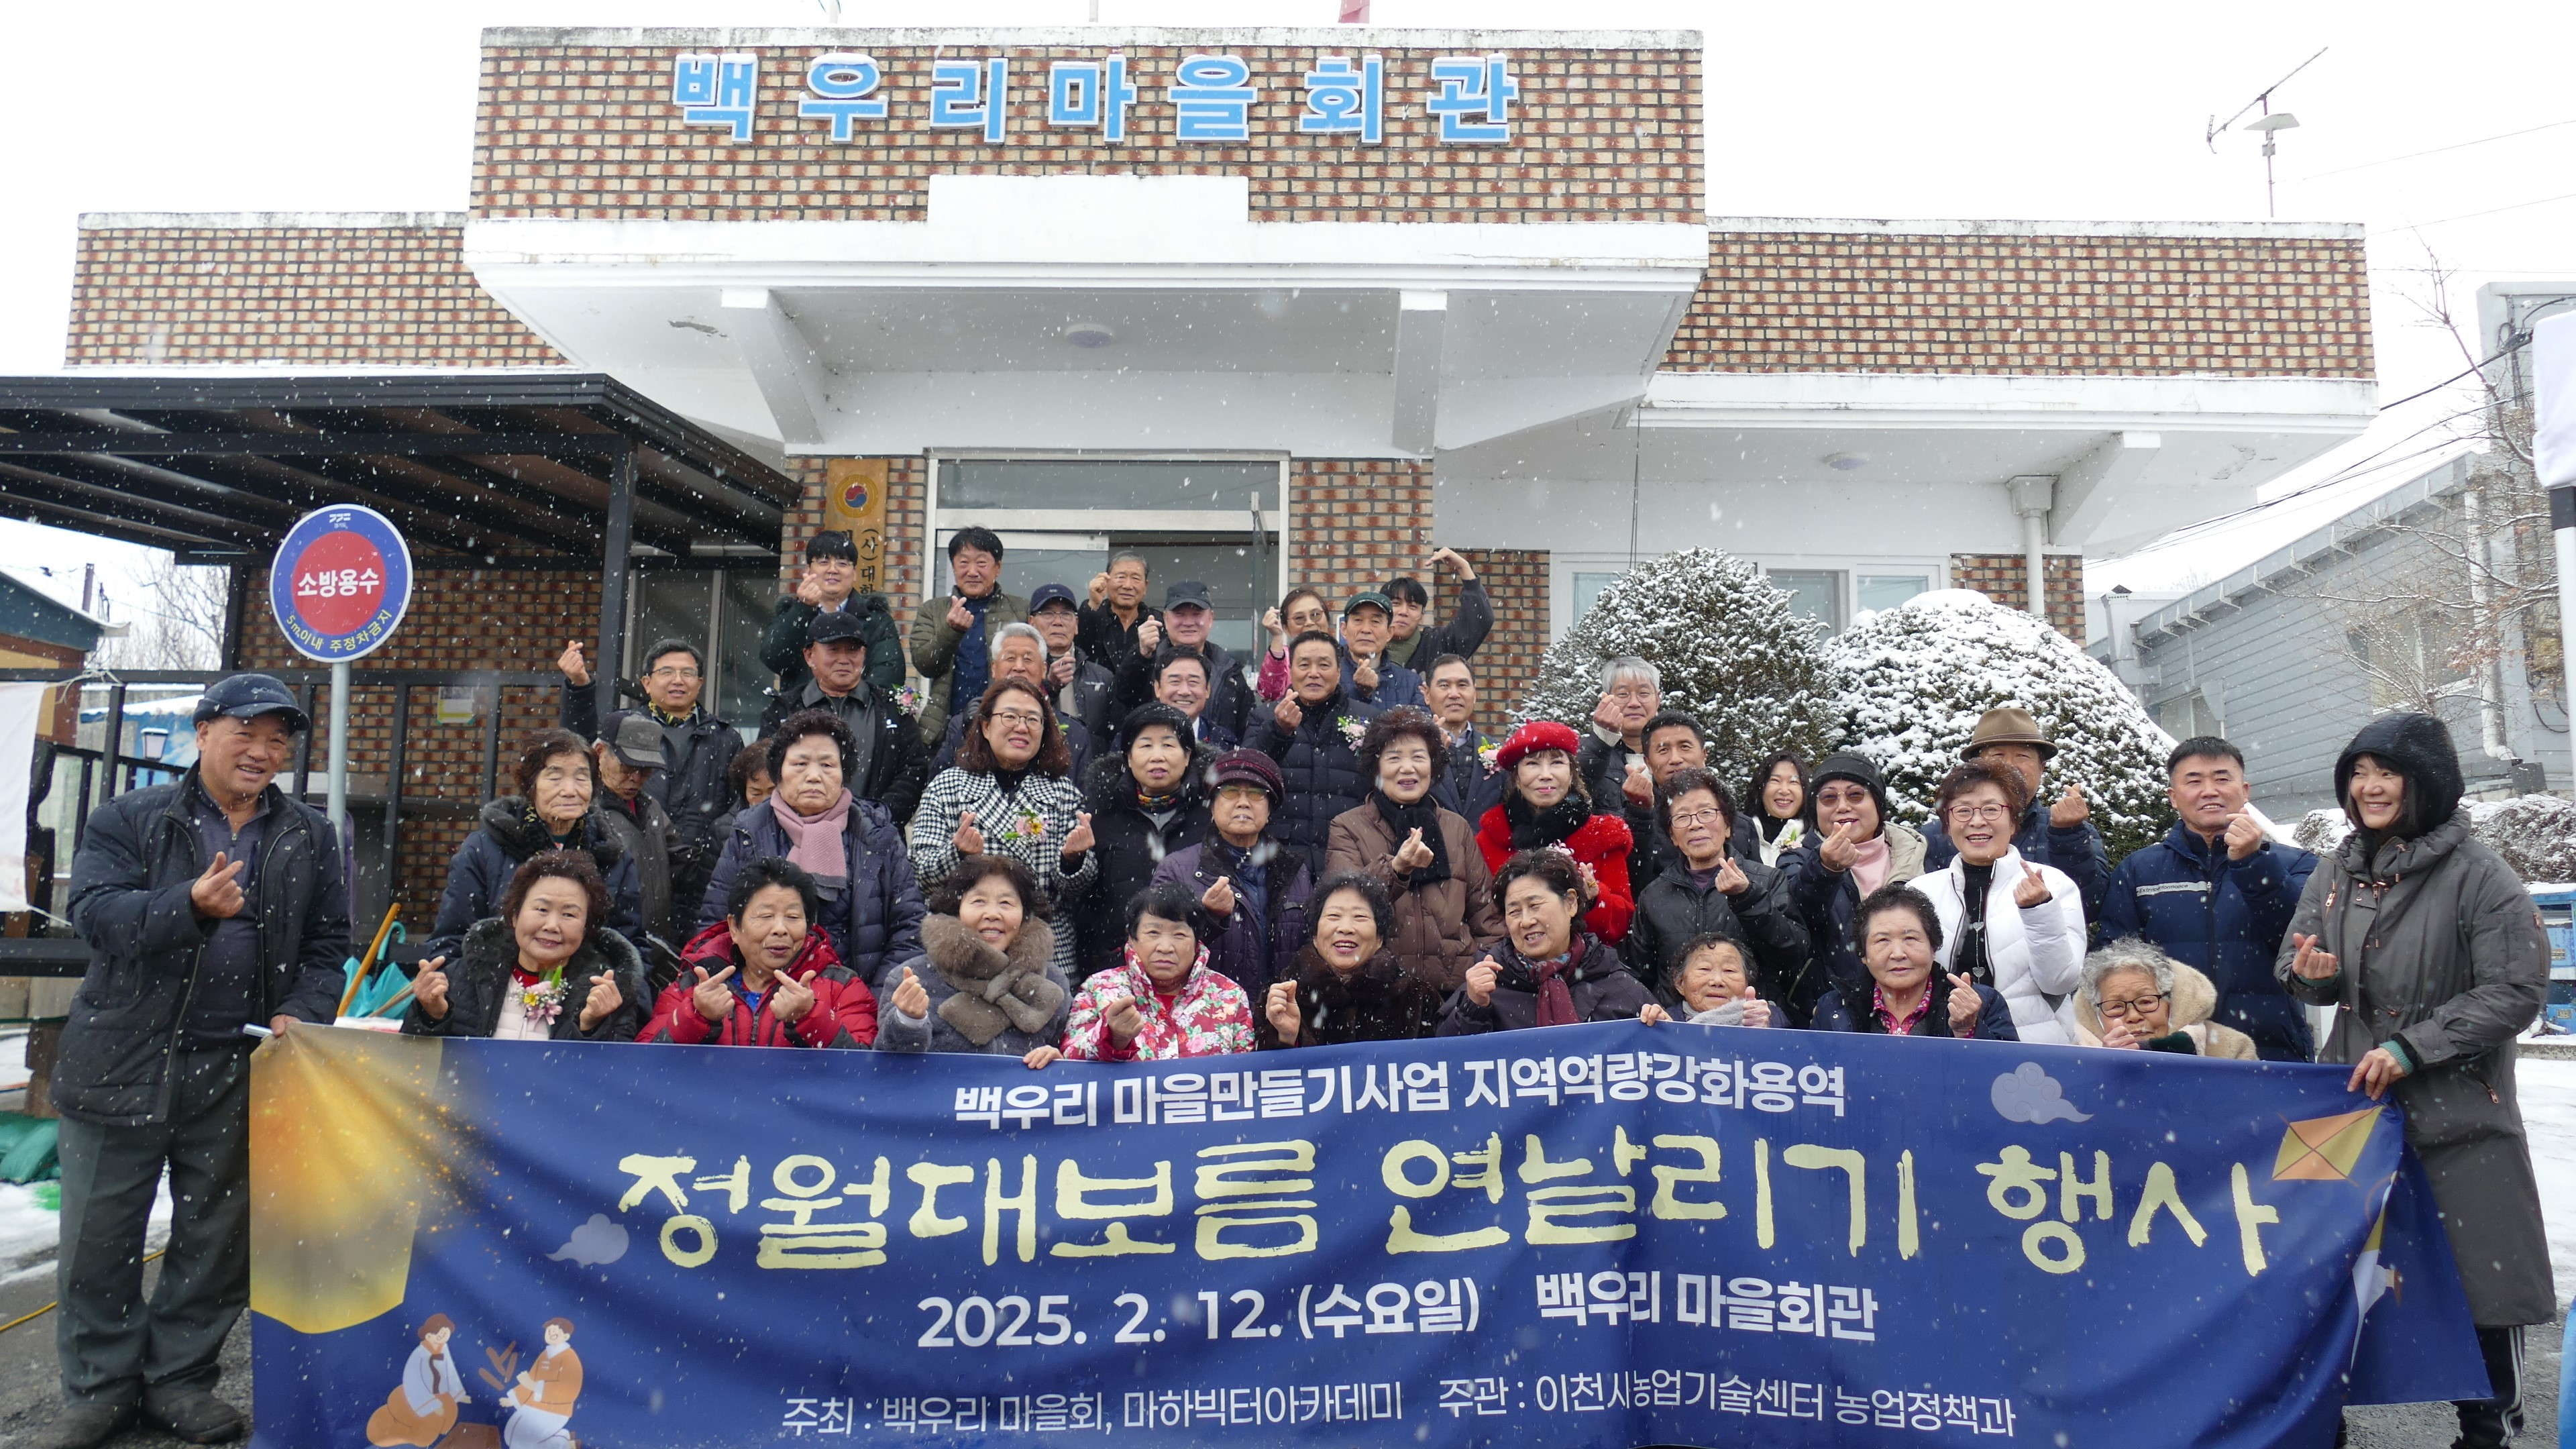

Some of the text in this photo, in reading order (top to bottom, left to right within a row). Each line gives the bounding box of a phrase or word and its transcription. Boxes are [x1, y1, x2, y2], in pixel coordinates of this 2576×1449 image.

[672, 53, 1518, 143] 백우리마을회관
[297, 568, 380, 598] 소방용수
[329, 608, 392, 653] 주정차금지
[954, 1051, 1844, 1130] 백우리 마을만들기사업 지역역량강화용역
[618, 1124, 2279, 1277] 정월대보름 연날리기 행사
[918, 1271, 1878, 1347] 2025. 2. 12. (수요일) 백우리 마을회관
[883, 1398, 986, 1434] 백우리
[1000, 1392, 1112, 1435] 마을회,
[1124, 1381, 1402, 1428] 마하빅터아카데미
[1536, 1369, 1823, 1421] 이천시농업기술센터
[1835, 1386, 2017, 1437] 농업정책과
